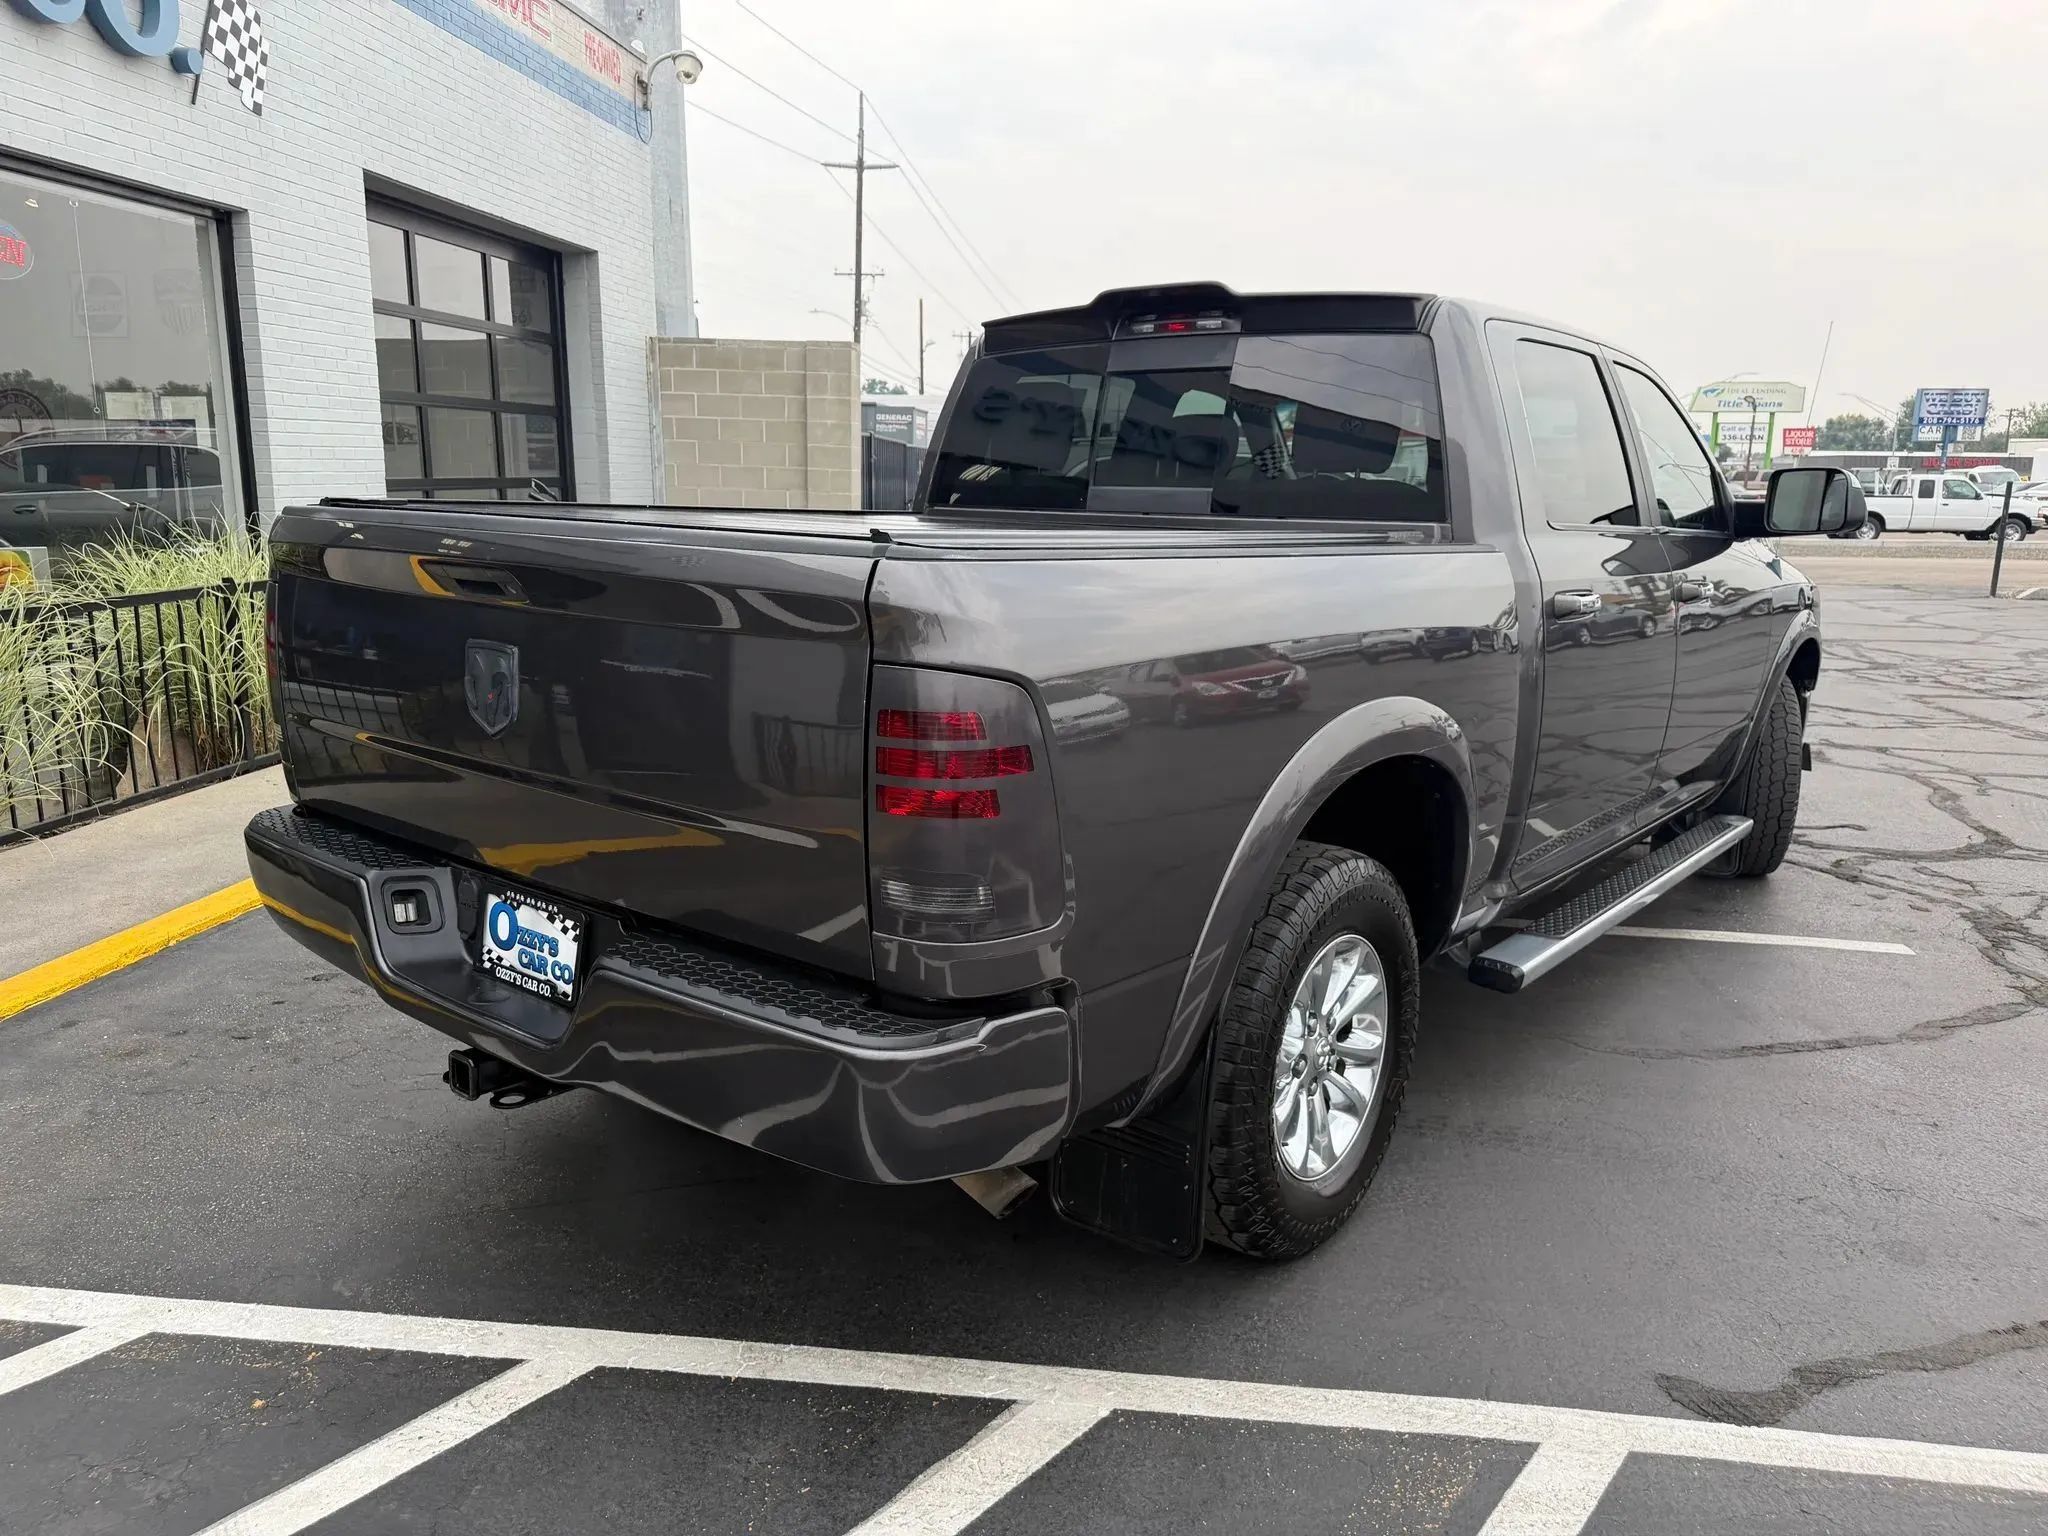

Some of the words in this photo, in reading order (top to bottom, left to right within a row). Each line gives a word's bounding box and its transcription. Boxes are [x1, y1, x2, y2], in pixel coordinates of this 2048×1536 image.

[1751, 387, 1787, 395] LENDING
[1951, 392, 1986, 402] BUY
[1717, 400, 1743, 408] Title
[1785, 430, 1815, 438] LIQUOR
[1919, 426, 1942, 434] CAR
[1785, 438, 1813, 446] STORE
[489, 901, 559, 957] OZZY'S
[518, 948, 548, 977] CAR
[551, 960, 574, 985] CO
[495, 966, 522, 986] OZZY'S
[522, 977, 538, 992] CAR
[539, 983, 552, 998] CO.
